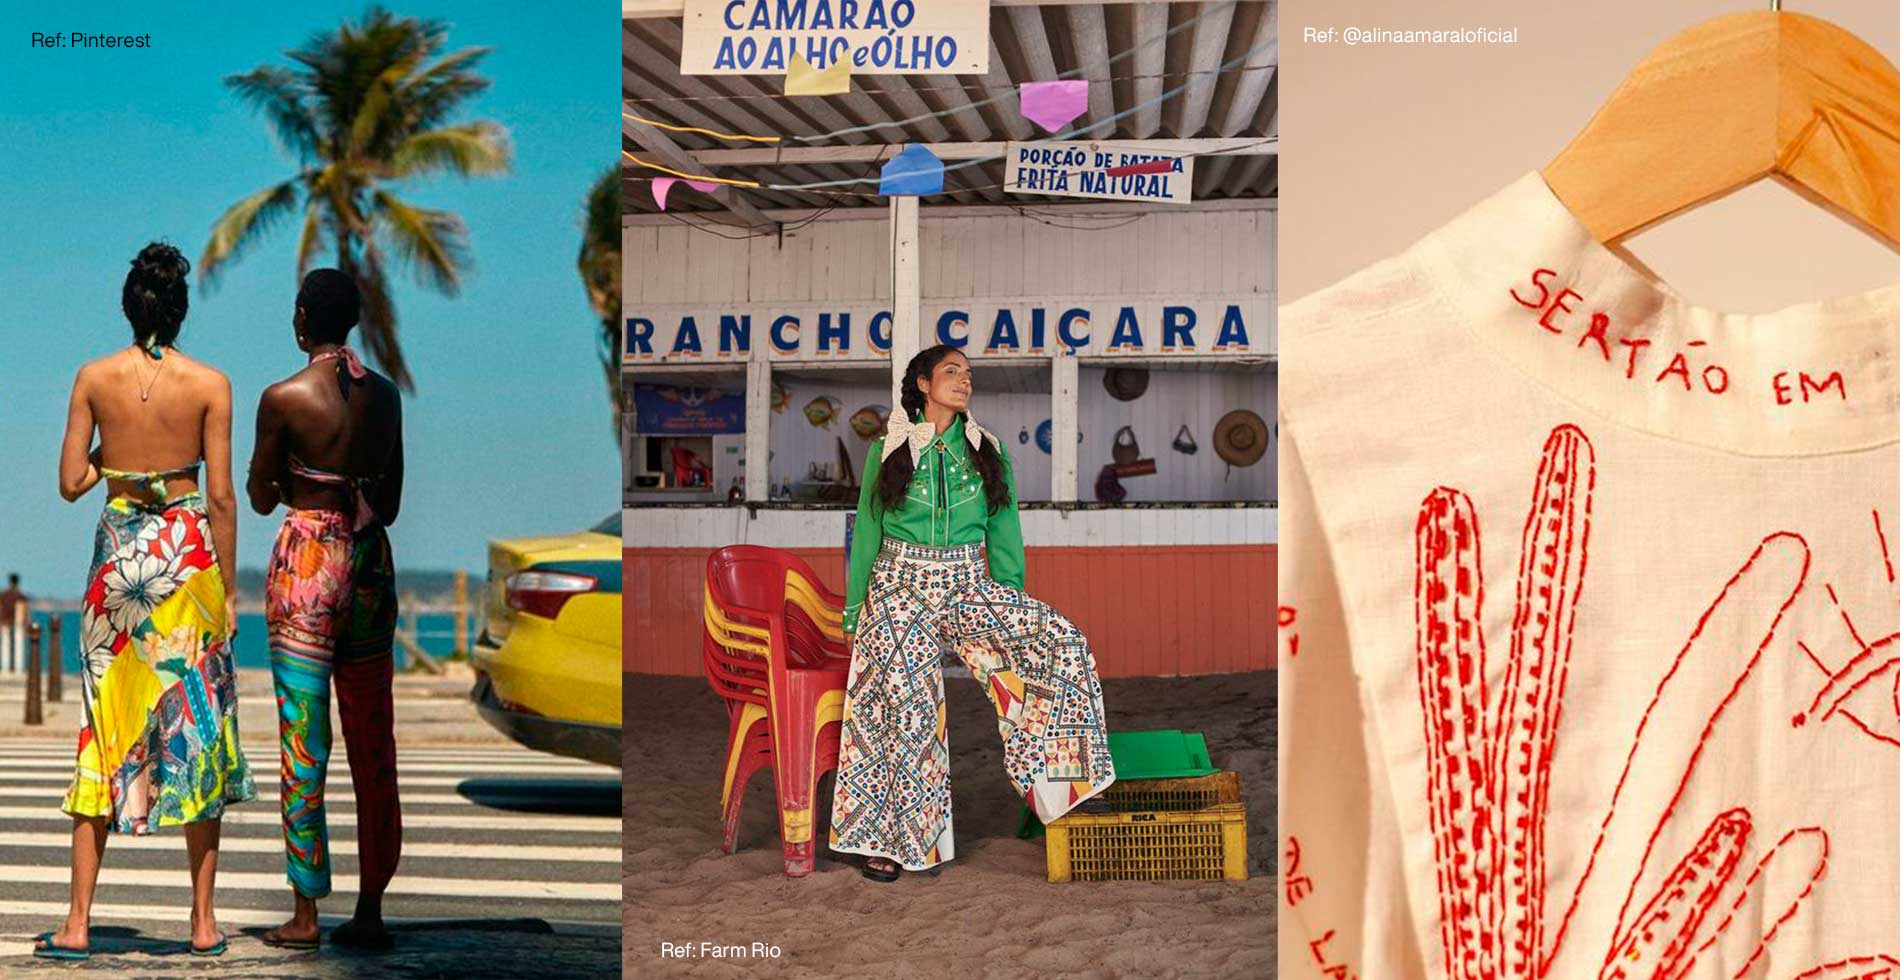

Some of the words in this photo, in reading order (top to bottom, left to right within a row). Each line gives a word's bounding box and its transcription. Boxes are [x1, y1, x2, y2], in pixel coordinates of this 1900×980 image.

[713, 36, 757, 70] AO
[1020, 147, 1087, 167] PORÇÃO
[1095, 153, 1113, 168] DE
[1121, 154, 1184, 173] BATA
[1017, 168, 1068, 191] FRITA
[624, 311, 893, 357] RANCHO
[936, 305, 1250, 356] CAIÇARA
[1510, 268, 1728, 394] SERTÃO
[1773, 371, 1846, 405] EM
